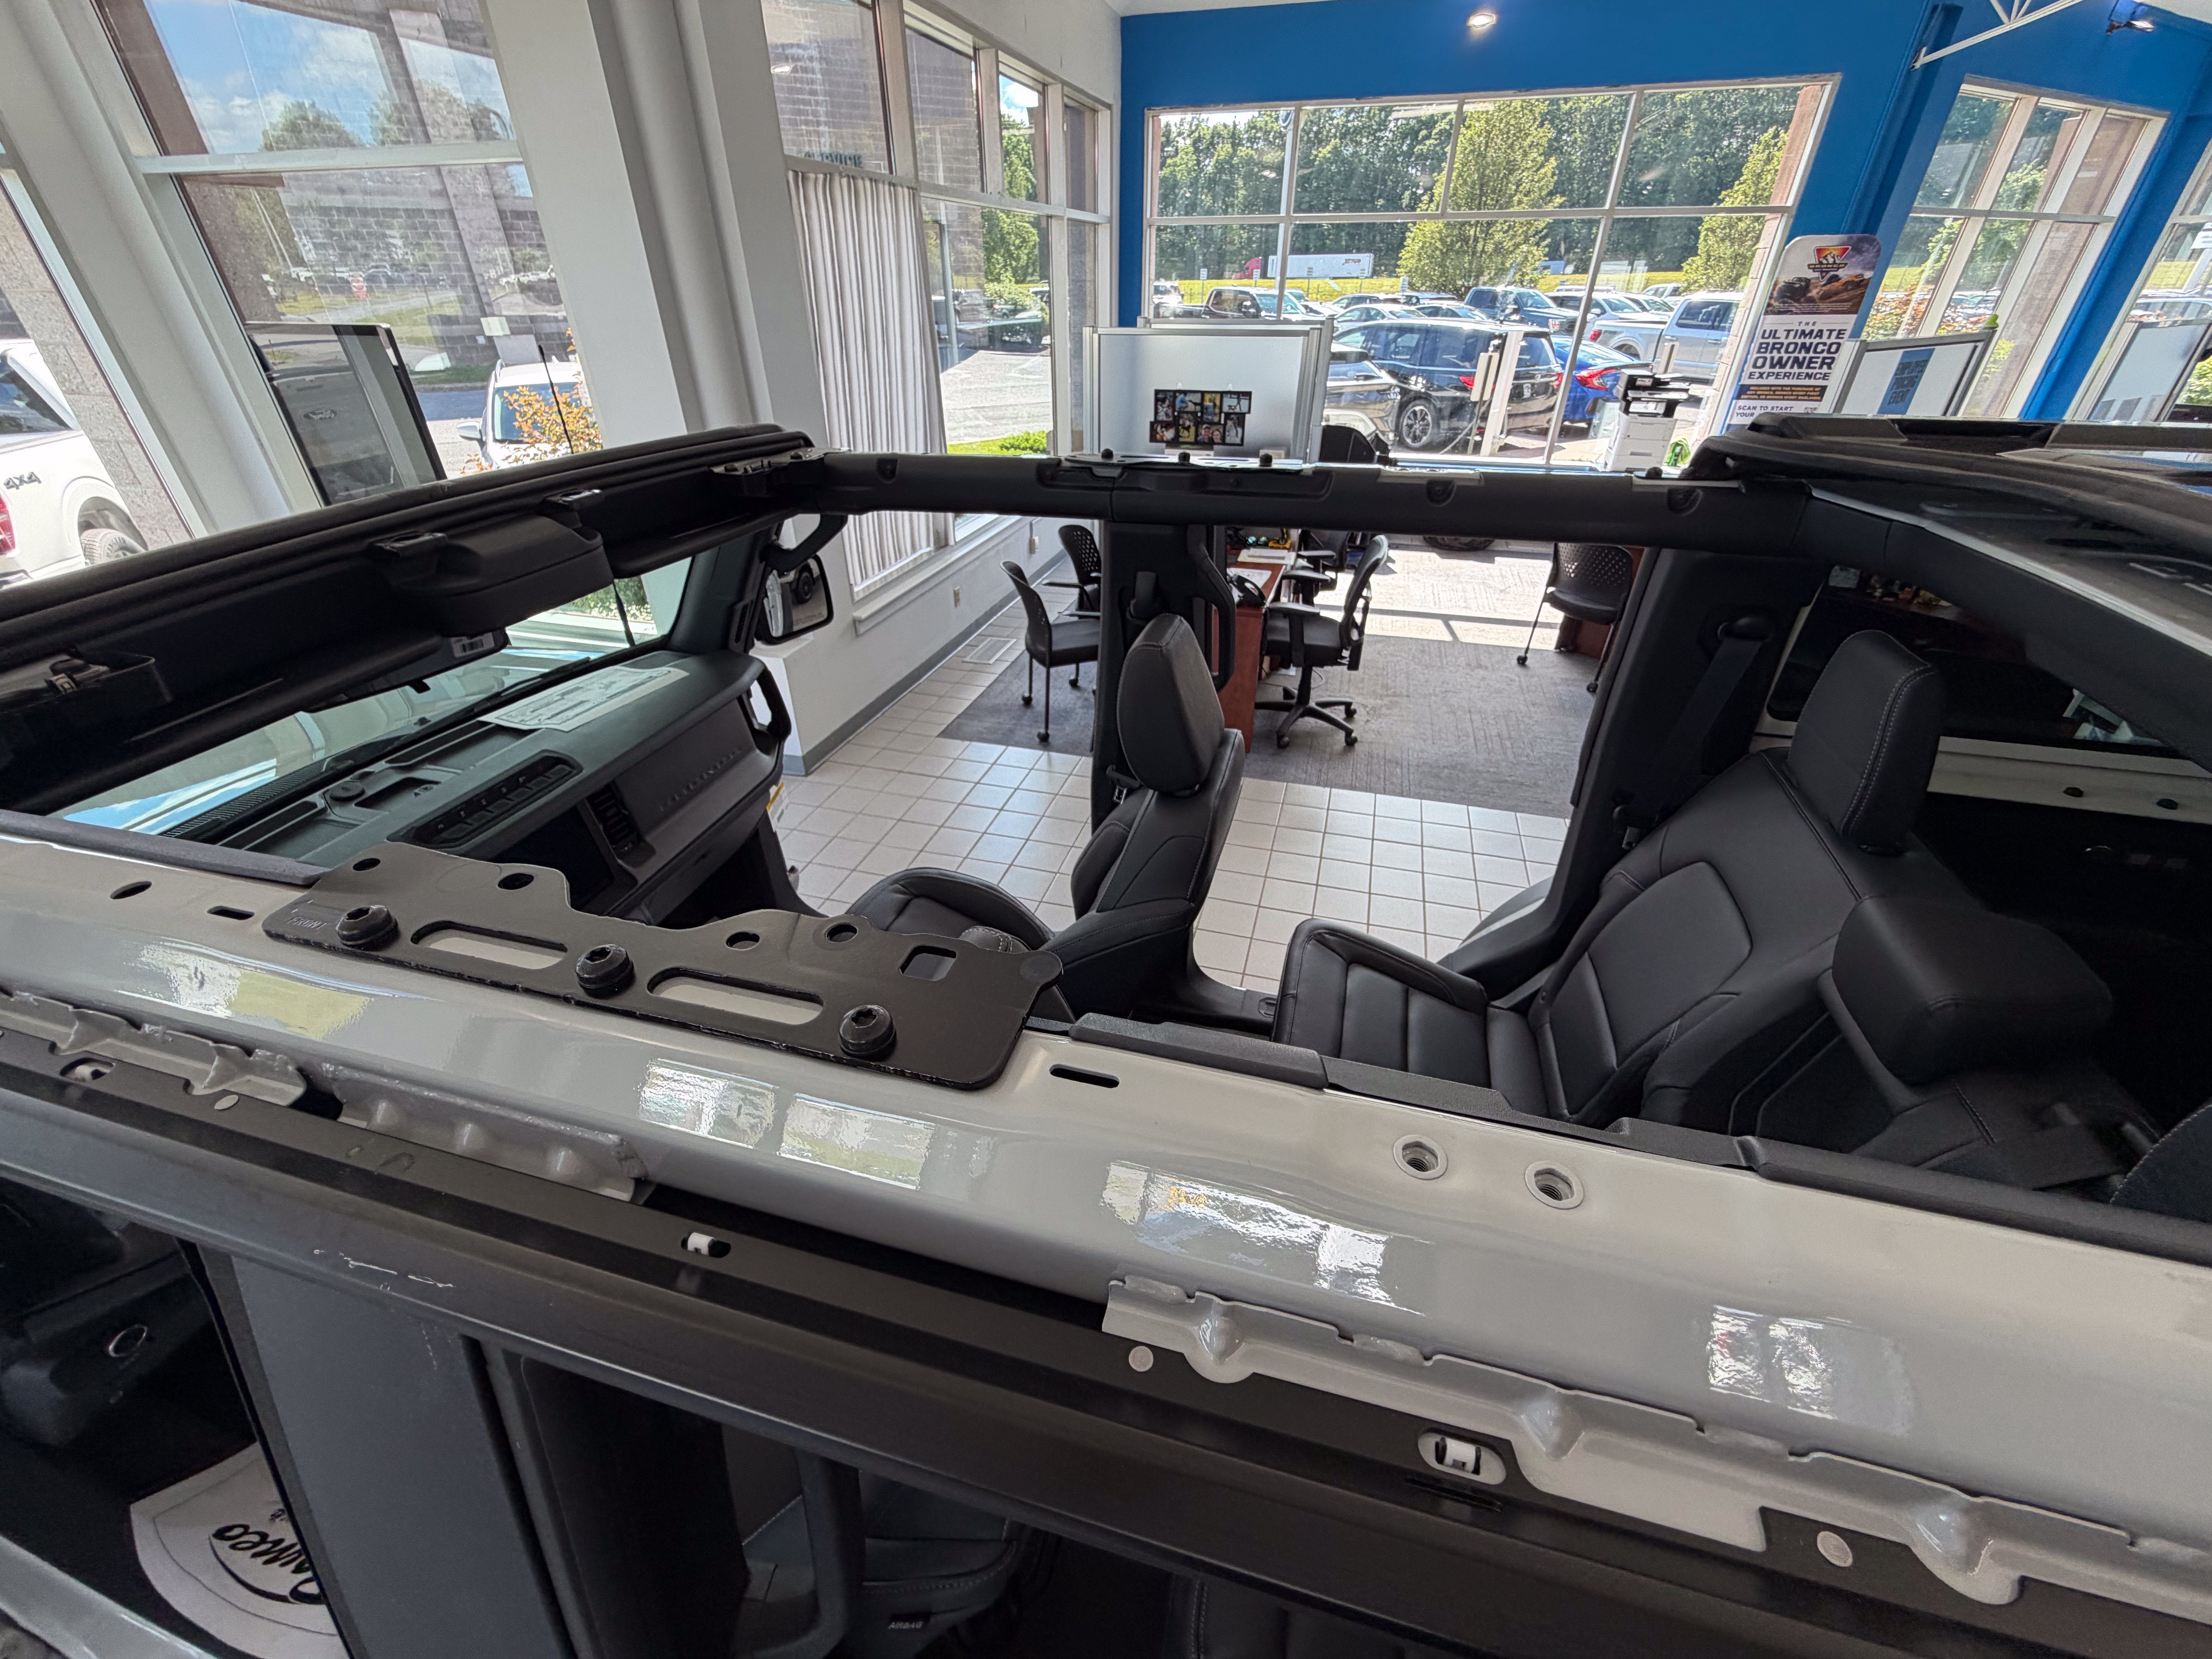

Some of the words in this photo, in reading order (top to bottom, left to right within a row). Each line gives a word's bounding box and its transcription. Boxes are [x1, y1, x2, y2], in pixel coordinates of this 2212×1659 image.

[1761, 329, 1847, 340] ULTIMATE
[1756, 342, 1841, 355] BRONCO
[1752, 356, 1836, 370] OWNER
[1747, 372, 1831, 380] EXPERIENCE
[287, 916, 330, 930] FRONT
